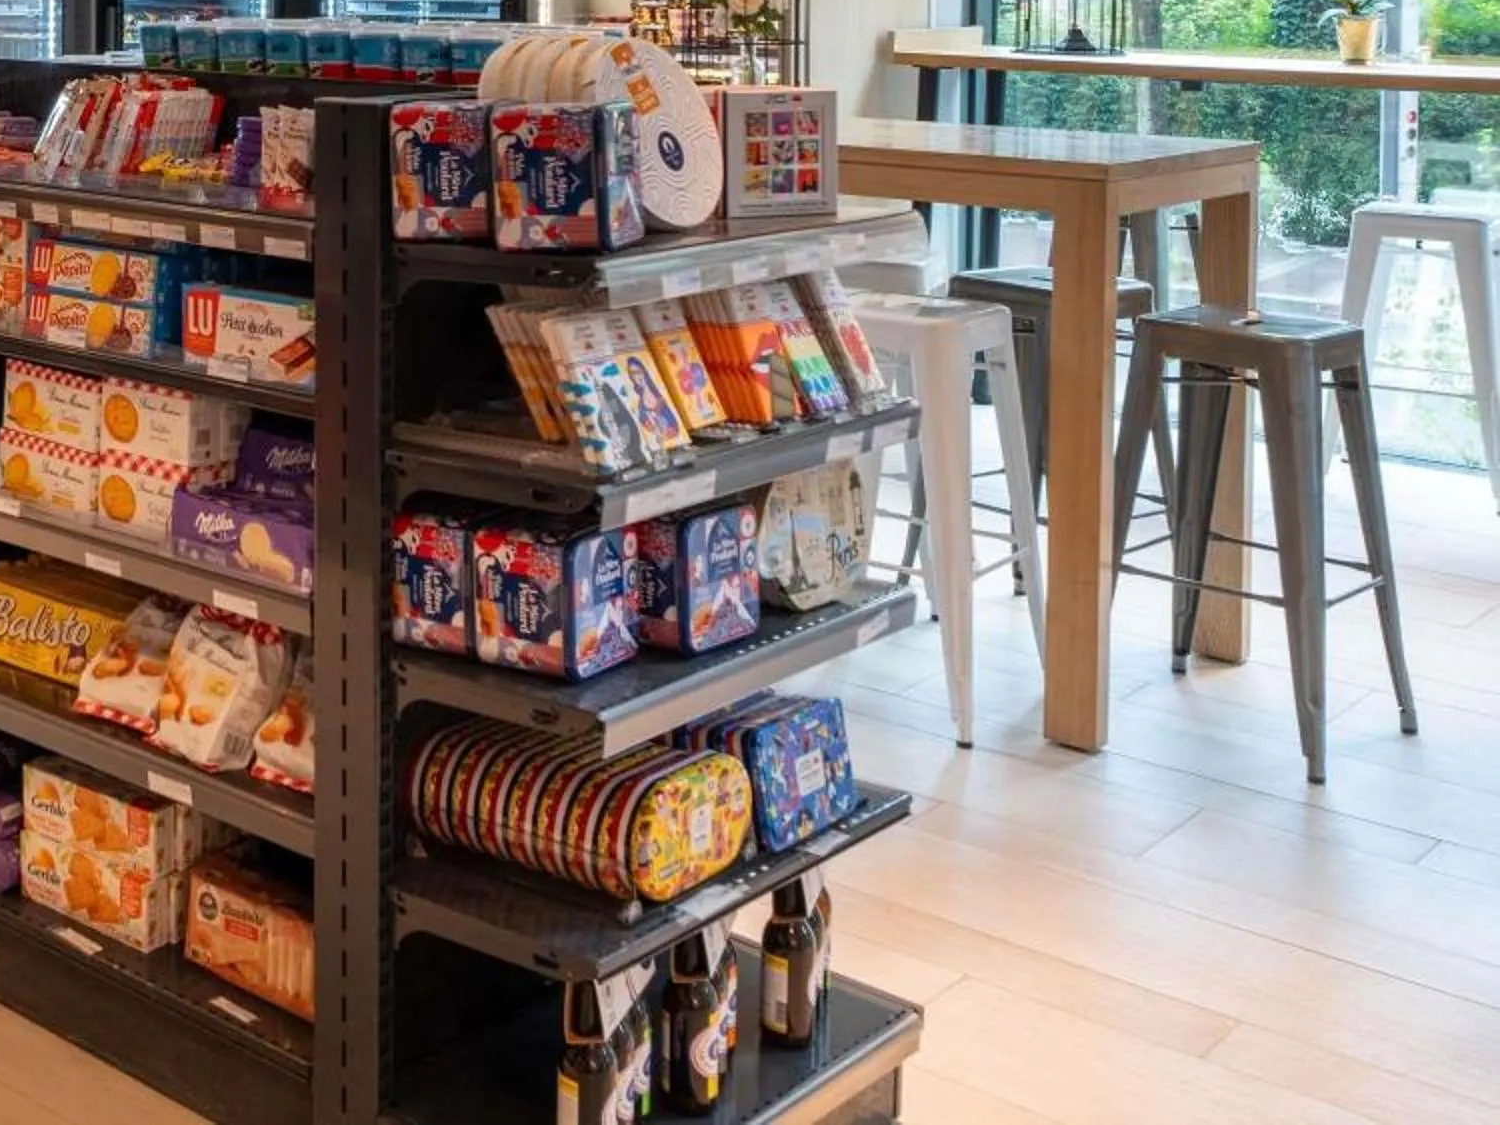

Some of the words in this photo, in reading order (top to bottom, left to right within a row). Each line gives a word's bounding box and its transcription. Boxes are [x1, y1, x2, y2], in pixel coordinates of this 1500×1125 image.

[33, 246, 50, 271] LU
[188, 295, 213, 336] LU
[195, 510, 235, 536] Milka
[826, 527, 859, 582] Paris
